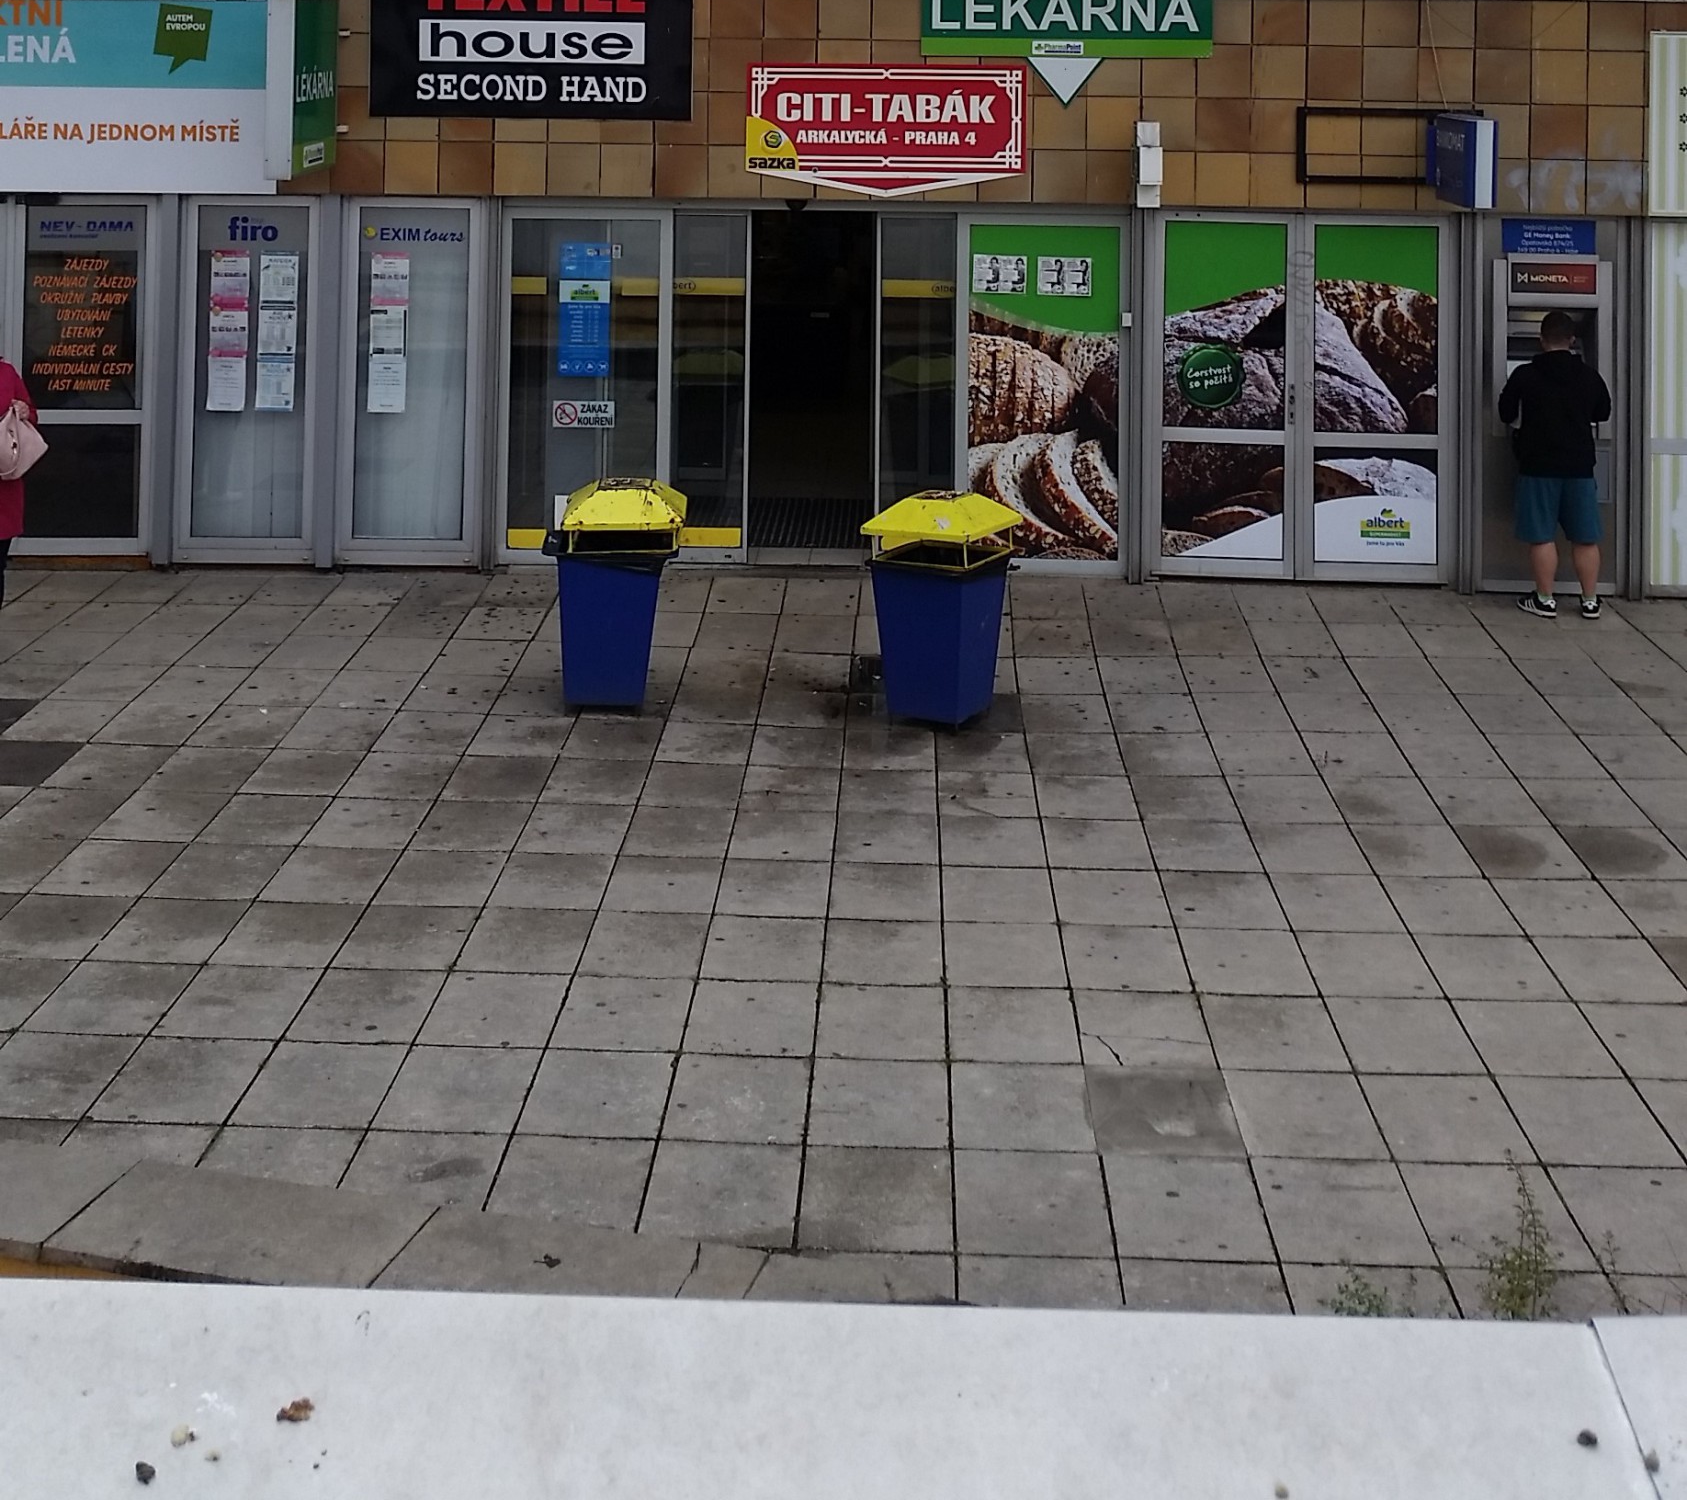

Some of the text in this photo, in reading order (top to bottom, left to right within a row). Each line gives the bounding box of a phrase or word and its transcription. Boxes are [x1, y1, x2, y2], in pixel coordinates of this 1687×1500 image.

[165, 14, 194, 22] AUTEM
[165, 23, 206, 31] EVROPOU
[430, 23, 633, 60] house
[296, 65, 334, 102] LÉKÁRNA
[417, 74, 646, 102] SECOND HAND
[777, 90, 996, 124] CITI-TABÁK
[53, 123, 83, 140] NA
[87, 123, 174, 144] JEDNOM
[181, 119, 240, 142] MÍSTĚ
[796, 128, 887, 145] ARKALYCKÁ
[904, 131, 960, 145] PRAHA
[964, 131, 977, 145] 4
[748, 157, 796, 170] sazka
[228, 216, 278, 241] firo
[380, 228, 464, 242] EXIM tours
[65, 258, 109, 271] ZÁJEZDY
[94, 275, 137, 288] ZÁJEZDY
[1530, 274, 1569, 283] MONETA
[91, 293, 128, 305] PLAVBY
[61, 326, 104, 339] LETENKY
[102, 344, 117, 356] CK
[102, 363, 134, 375] CESTY
[48, 379, 71, 391] LAST
[580, 401, 608, 413] ZÁKAZ
[577, 414, 613, 426] KOUŘENÍ
[1366, 516, 1405, 528] albert
